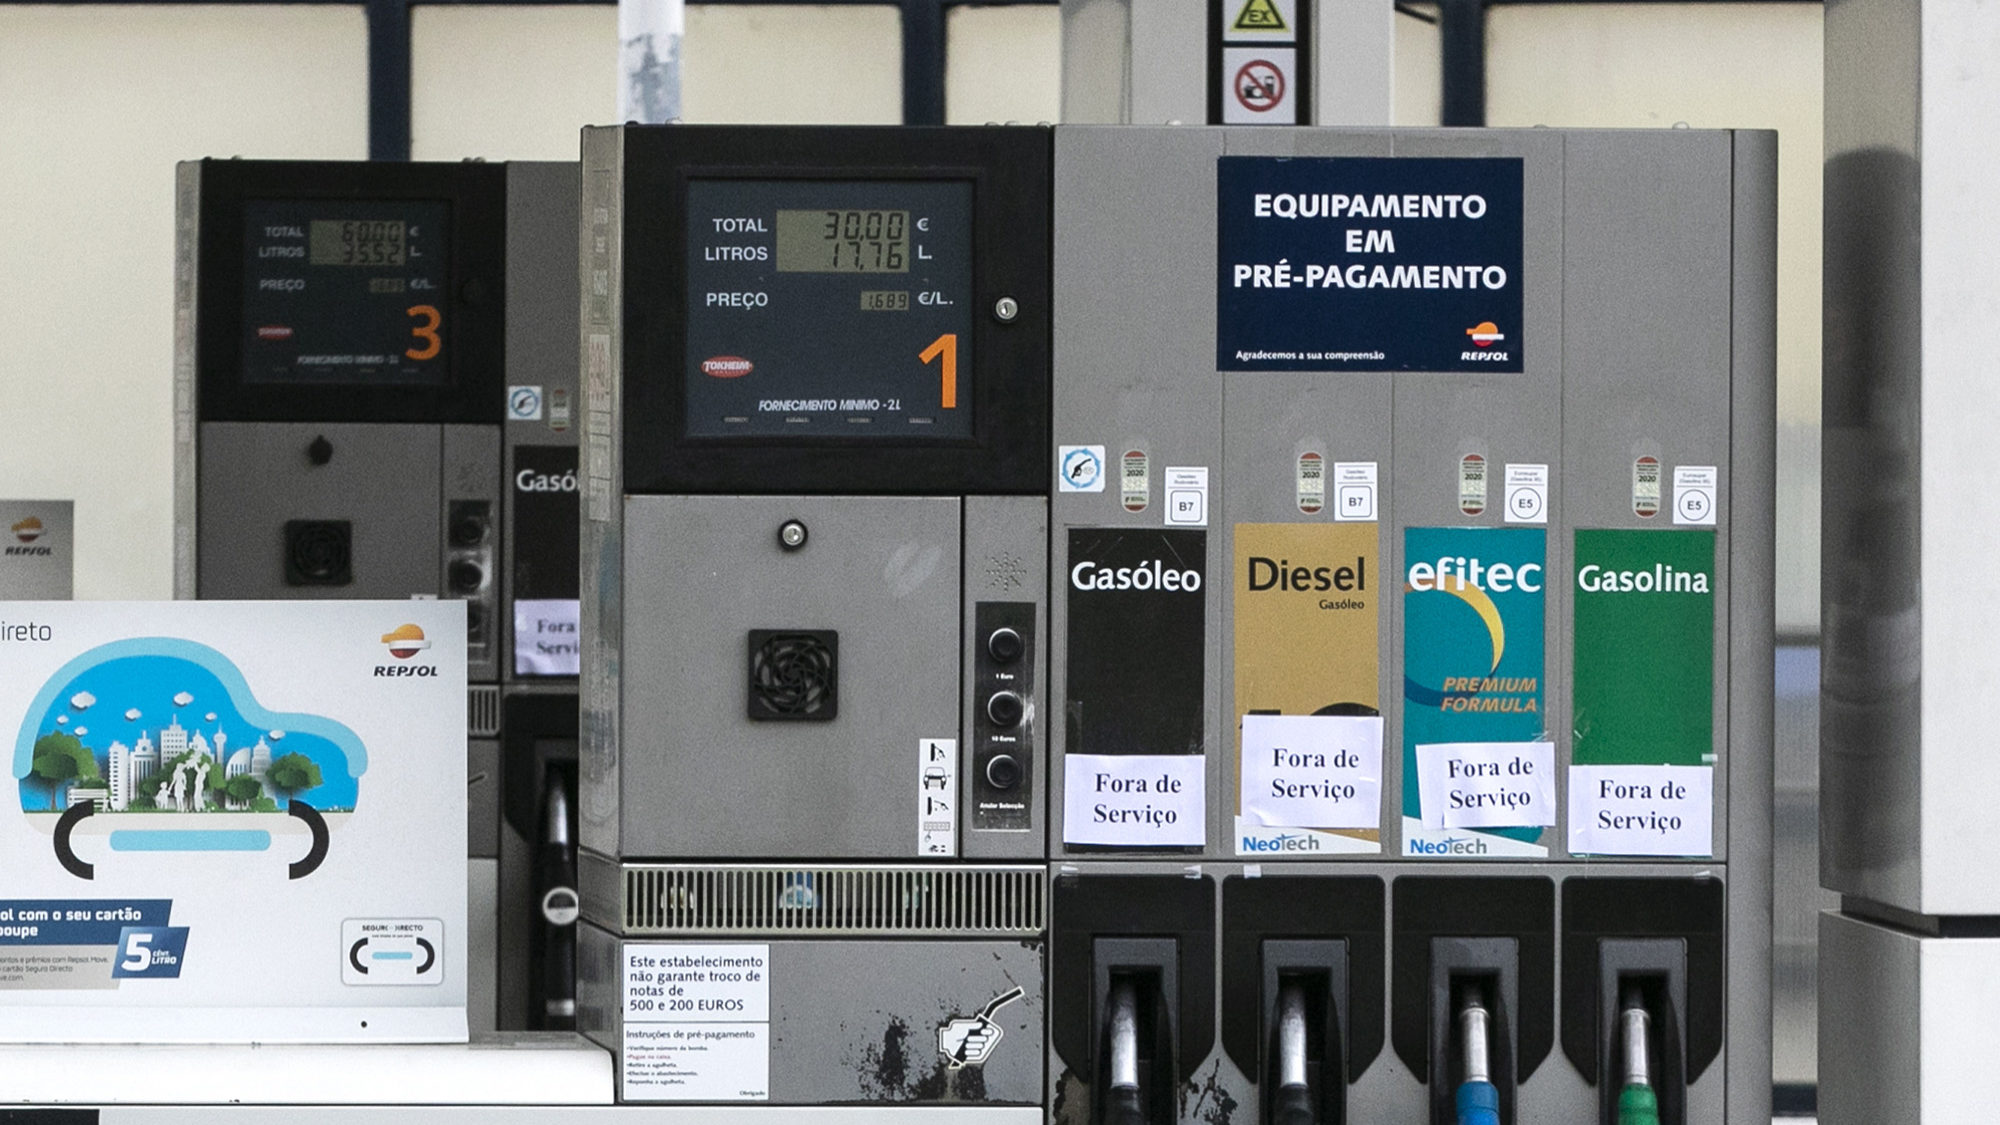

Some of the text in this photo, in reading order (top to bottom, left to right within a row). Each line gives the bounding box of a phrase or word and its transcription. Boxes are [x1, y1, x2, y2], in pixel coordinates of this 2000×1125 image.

[1249, 9, 1271, 23] EX
[1254, 194, 1486, 219] EQUIPAMENTO
[265, 226, 304, 237] TOTAL
[713, 218, 768, 232] TOTAL
[917, 218, 928, 231] €
[1346, 230, 1395, 253] EM
[258, 246, 305, 258] LITROS
[705, 247, 768, 260] LITROS
[1234, 258, 1507, 290] PRÉ-PAGAMENTO
[260, 279, 306, 292] PREÇO
[707, 293, 768, 310] PREÇO
[918, 292, 953, 305] €/L.
[406, 305, 441, 360] 3
[1236, 350, 1385, 362] Agradecemos a sua compreensão
[1461, 352, 1508, 362] REPSOL
[918, 334, 956, 409] 1
[758, 400, 837, 411] FORNECIMENTO
[839, 399, 880, 411] MINIMO
[1127, 469, 1144, 477] 2020
[1179, 502, 1194, 511] B7
[1349, 497, 1364, 507] B7
[1519, 499, 1533, 508] E5
[1688, 501, 1702, 510] E5
[1072, 560, 1200, 592] Gasóleo
[1249, 556, 1365, 591] Diesel
[1408, 556, 1542, 592] efitec
[1578, 563, 1710, 593] Gasolina
[1319, 599, 1365, 610] Gasóleo
[2, 620, 52, 642] ireto
[537, 619, 576, 634] Fora
[374, 666, 438, 677] REPSOL
[1443, 677, 1538, 692] PREMIUM
[1440, 698, 1537, 712] FORMULA
[1274, 748, 1360, 768] Fora de
[1448, 757, 1534, 778] Fora de
[1095, 773, 1182, 793] Fora de
[1272, 779, 1355, 802] Serviço
[1600, 780, 1686, 800] Fora de
[1450, 788, 1531, 810] Serviço
[1094, 804, 1177, 828] Serviço
[1598, 810, 1682, 834] Serviço
[1243, 834, 1320, 852] NeoTech
[1410, 837, 1487, 854] NeoTech
[18, 910, 48, 921] com
[52, 910, 62, 921] o
[66, 910, 91, 921] seu
[95, 907, 142, 921] cartão
[121, 933, 152, 971] 5
[152, 957, 177, 965] LITRO
[630, 956, 763, 968] Este estabelecimento
[630, 970, 760, 985] não garante troco de
[630, 984, 684, 996] notas de
[630, 999, 744, 1011] 500 e 200 EUROS
[626, 1030, 755, 1040] Instruções de pré-pagamento
